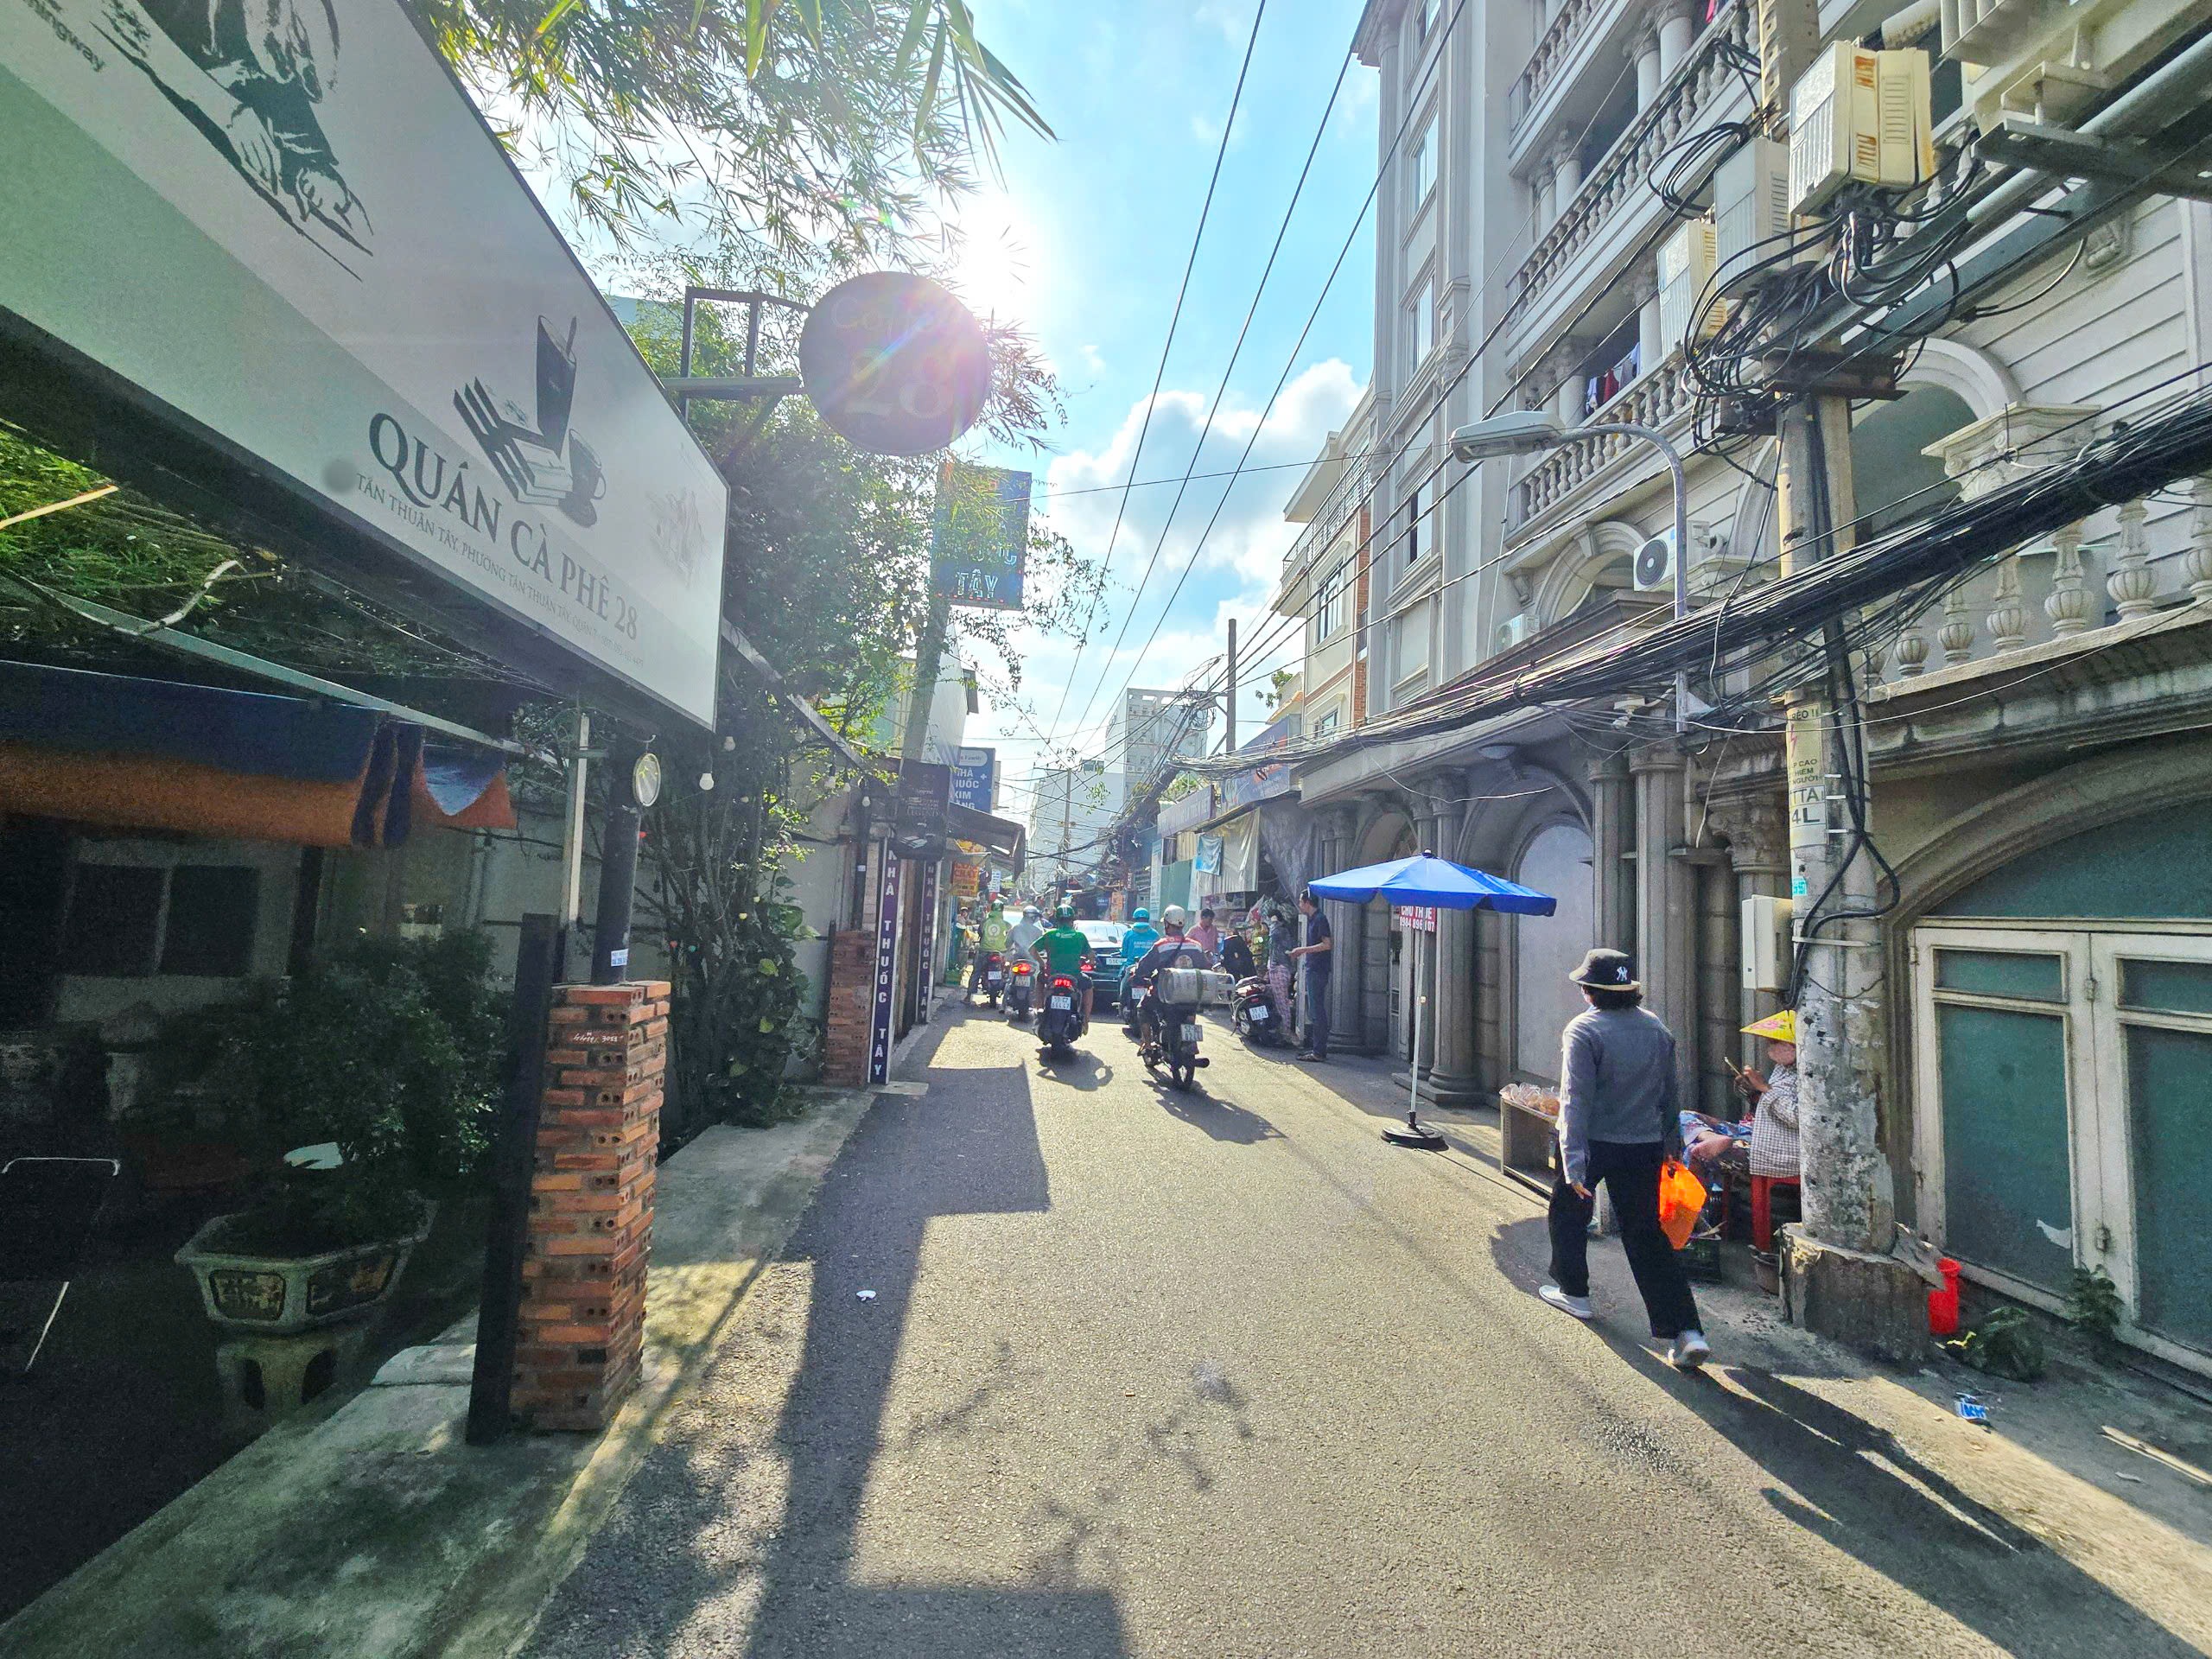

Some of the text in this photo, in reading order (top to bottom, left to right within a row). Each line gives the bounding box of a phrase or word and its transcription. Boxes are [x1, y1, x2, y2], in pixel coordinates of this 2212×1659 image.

[369, 412, 638, 640] QUÁN CÀ PHÊ 28
[956, 569, 999, 598] TÂY
[878, 920, 892, 1002] THUỐC
[1616, 966, 1628, 982] NY
[874, 1028, 887, 1075] TÂY
